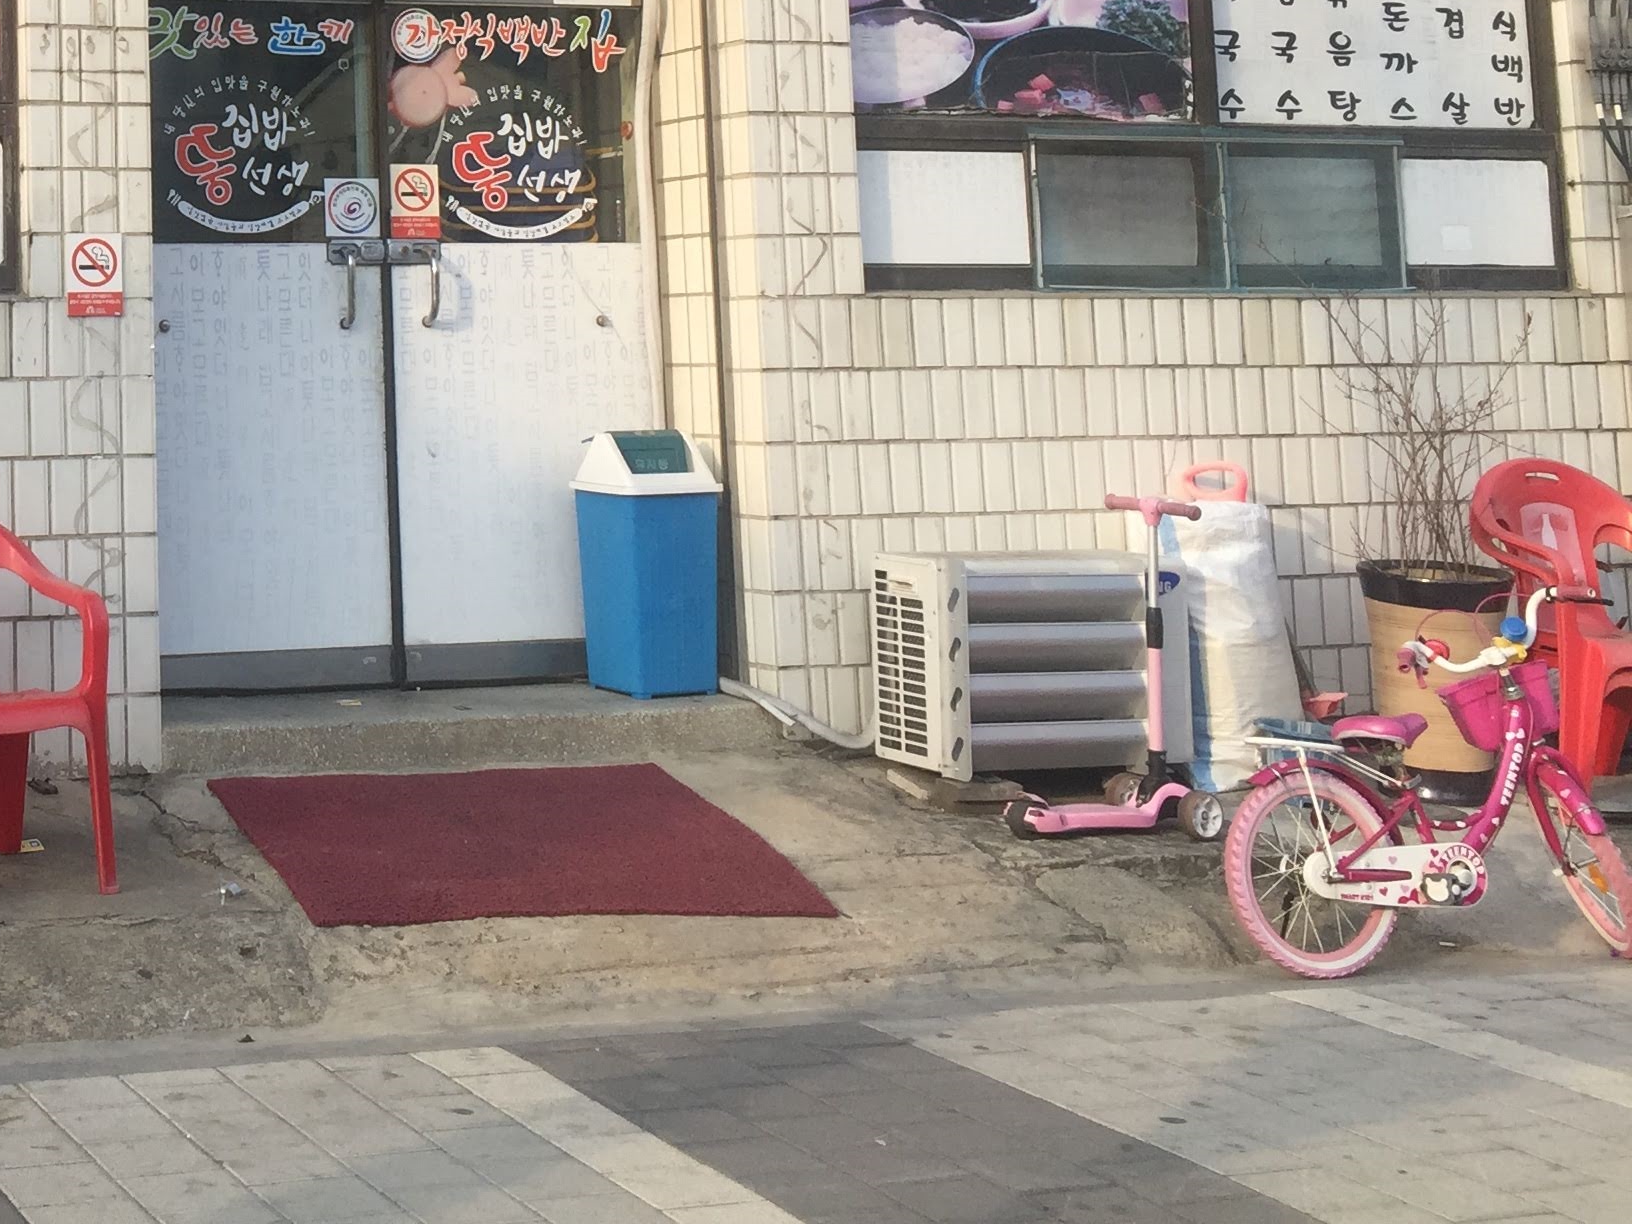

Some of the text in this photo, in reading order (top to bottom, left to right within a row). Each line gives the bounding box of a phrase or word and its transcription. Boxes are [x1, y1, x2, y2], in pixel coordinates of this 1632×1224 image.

[268, 15, 355, 56] 한끼
[221, 102, 297, 152] 집밥
[496, 111, 570, 160] 집밥
